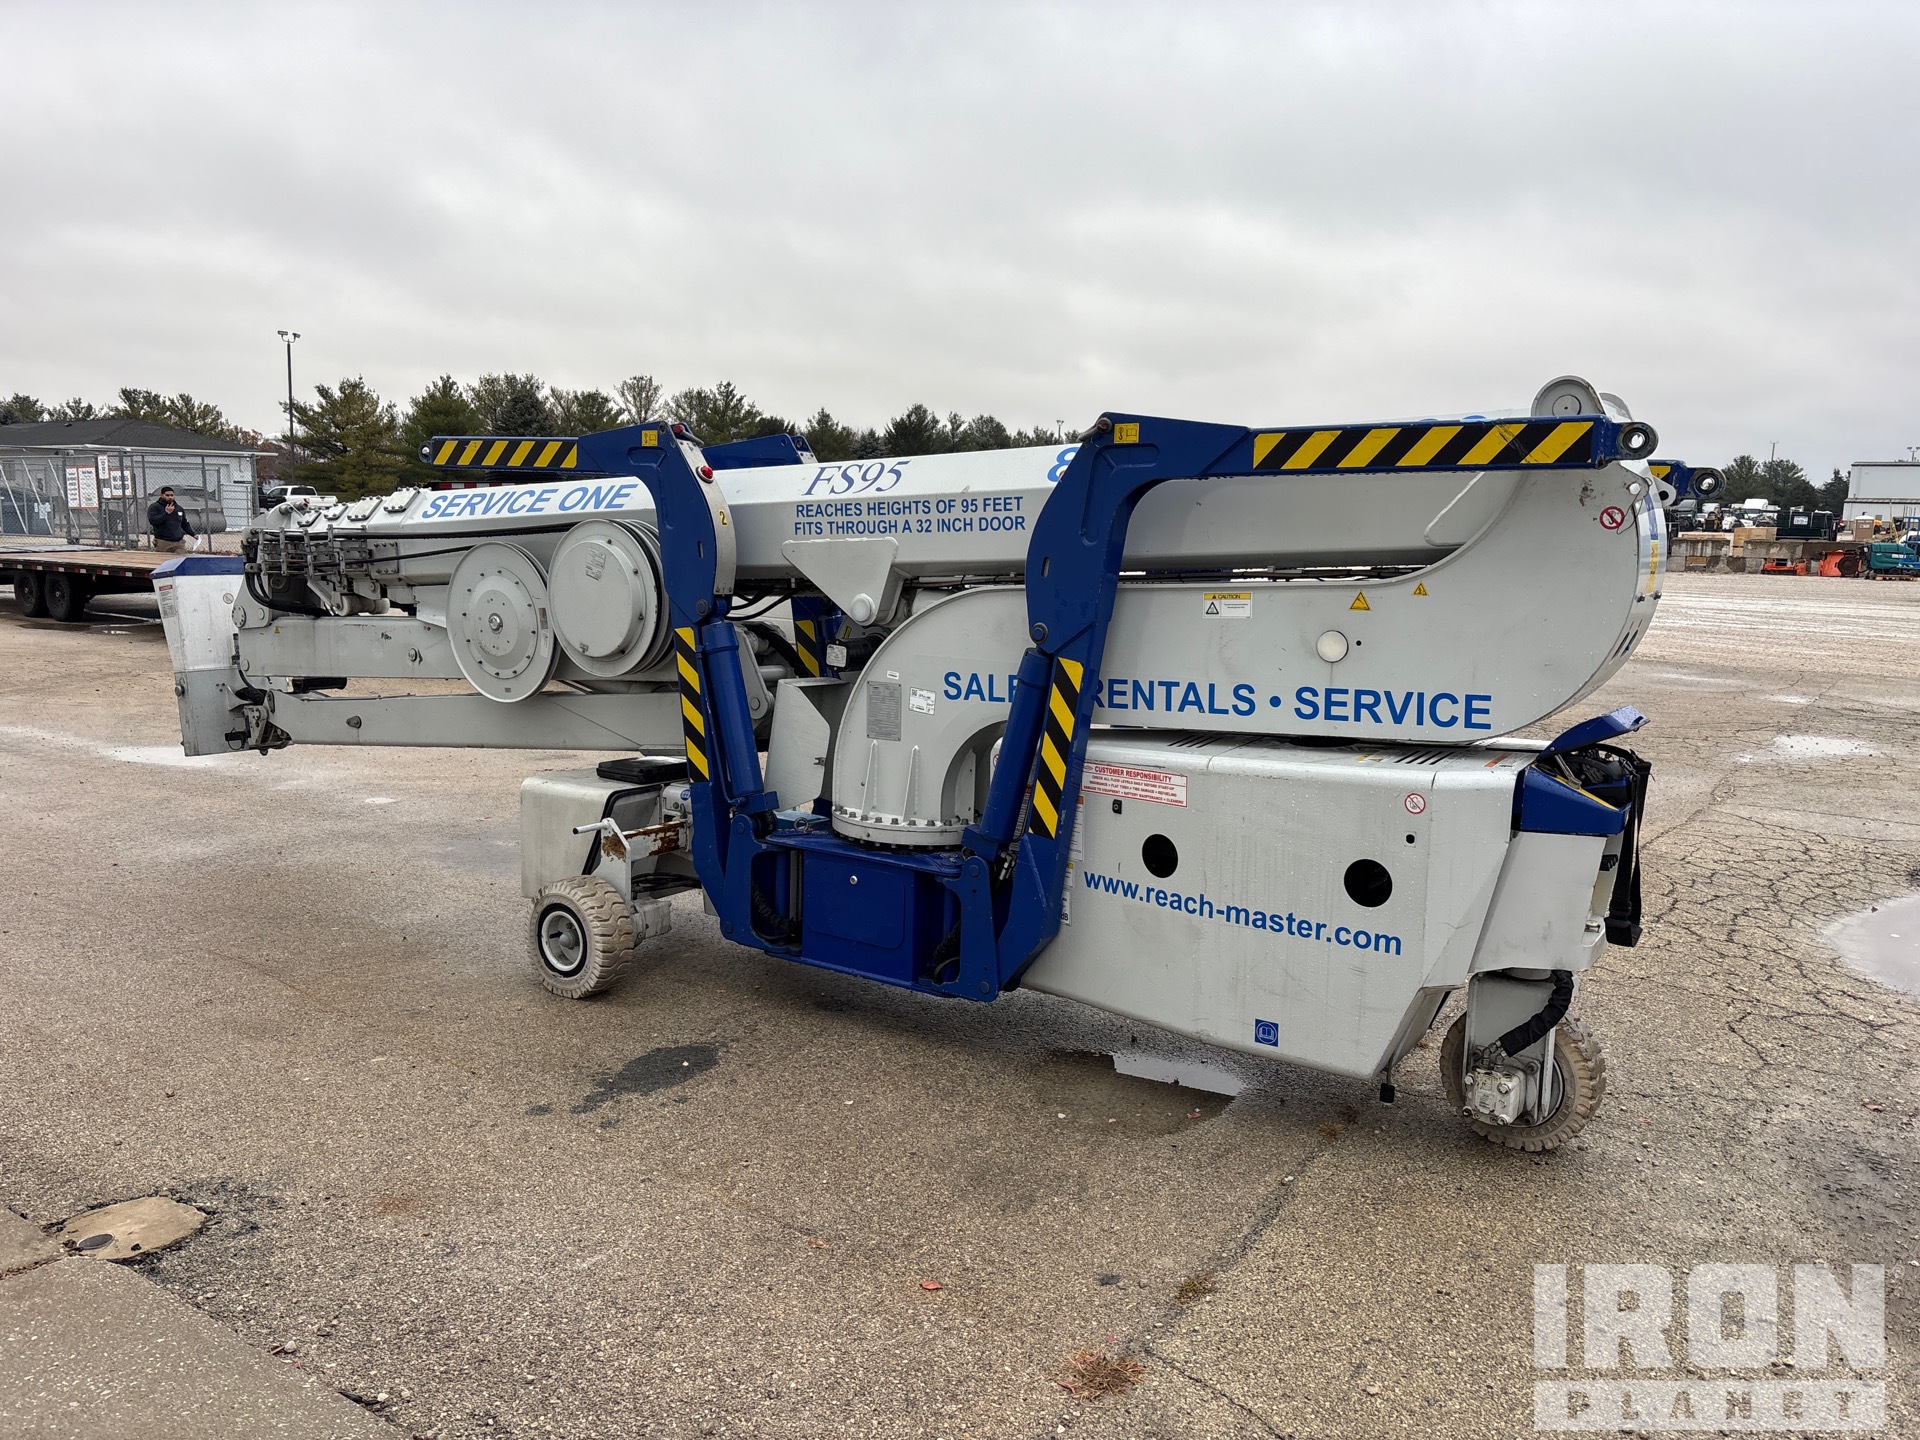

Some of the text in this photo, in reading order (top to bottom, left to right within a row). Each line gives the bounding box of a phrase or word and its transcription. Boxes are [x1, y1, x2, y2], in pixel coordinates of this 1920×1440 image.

[801, 460, 911, 496] FS95
[421, 483, 639, 519] SERVICE ONE
[796, 496, 1024, 518] REACHES HEIGHTS OF 95 FEET
[719, 510, 727, 525] 2
[794, 515, 1026, 535] FITS THROUGH A 32 INCH DOOR
[943, 672, 1020, 703] SALE
[1294, 686, 1492, 730] SERVICE
[1094, 765, 1172, 783] CUSTOMER RESPONSIBILITY
[1083, 870, 1402, 956] www.reach-master.com
